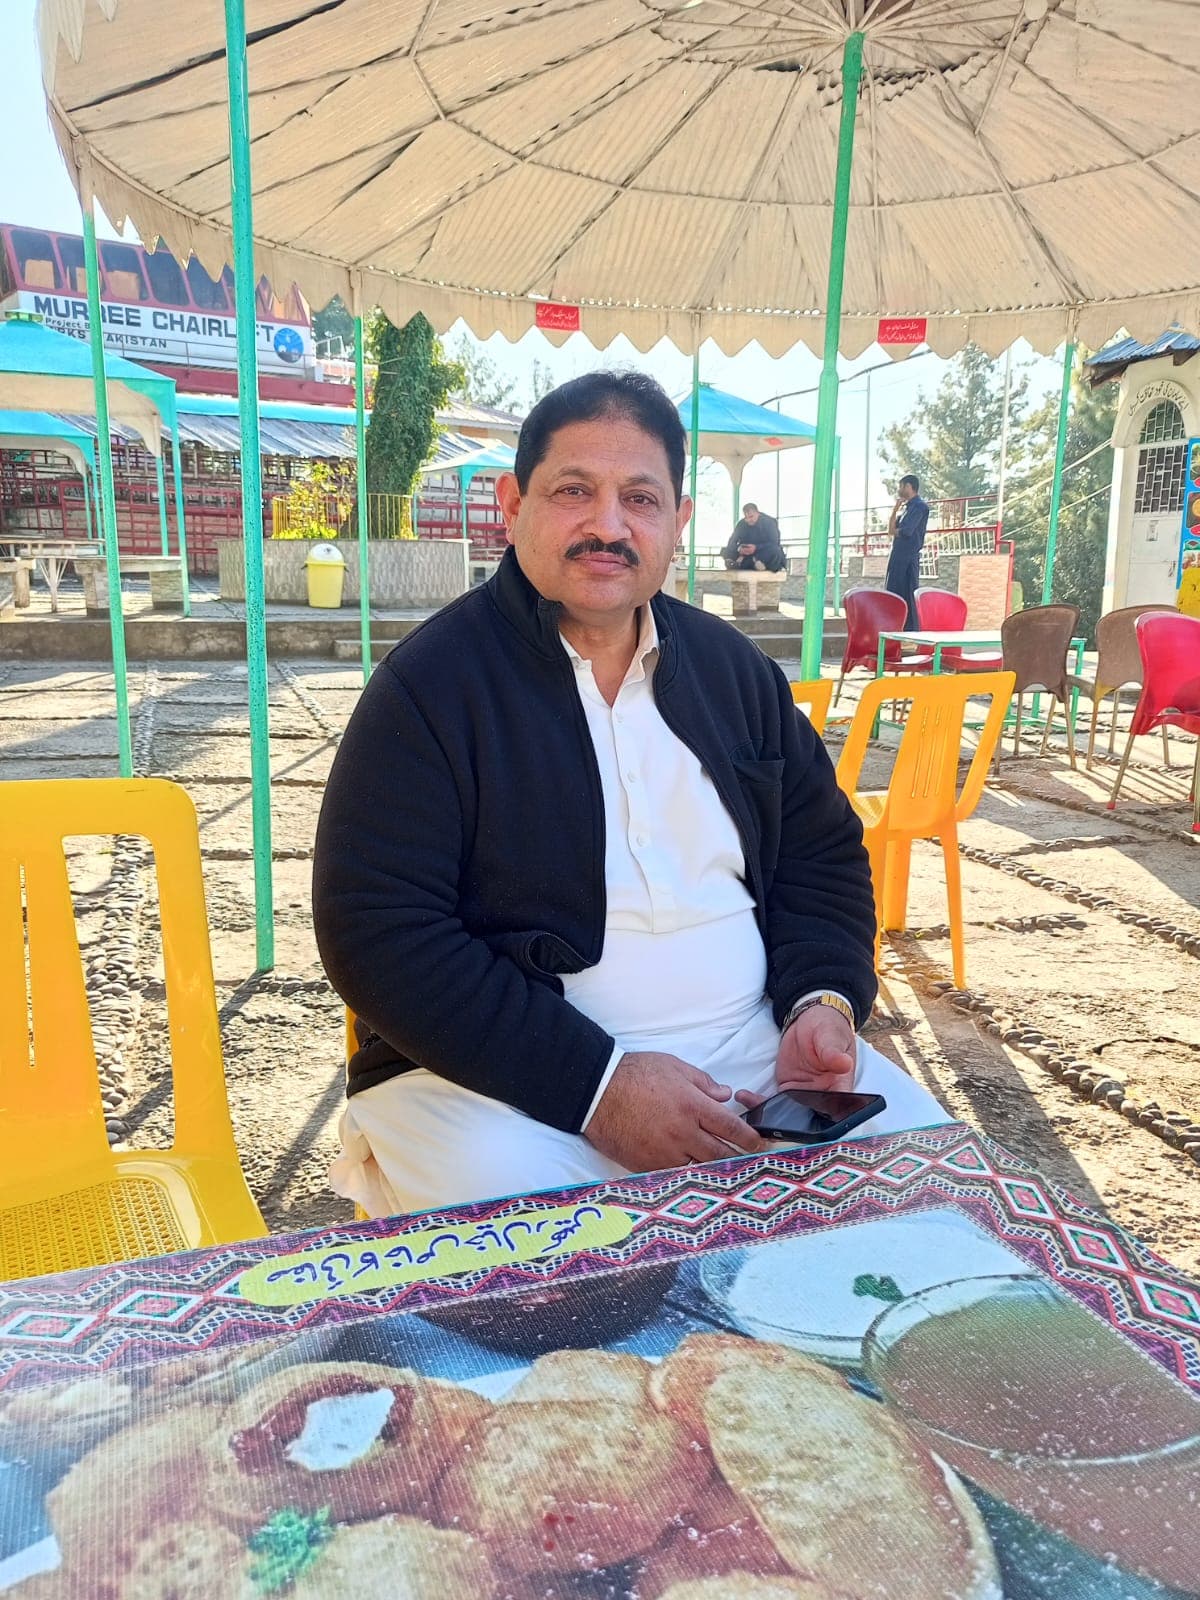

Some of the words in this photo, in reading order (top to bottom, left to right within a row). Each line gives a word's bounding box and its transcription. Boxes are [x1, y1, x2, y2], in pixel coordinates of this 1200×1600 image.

[46, 317, 81, 329] Project
[152, 311, 274, 342] CHAIRLT
[106, 332, 167, 349] AKISTAN
[267, 1253, 351, 1290] صفائی
[353, 1251, 380, 1279] کا
[384, 1233, 460, 1268] خاص
[464, 1221, 532, 1252] خیال
[535, 1206, 603, 1253] رکھیں
